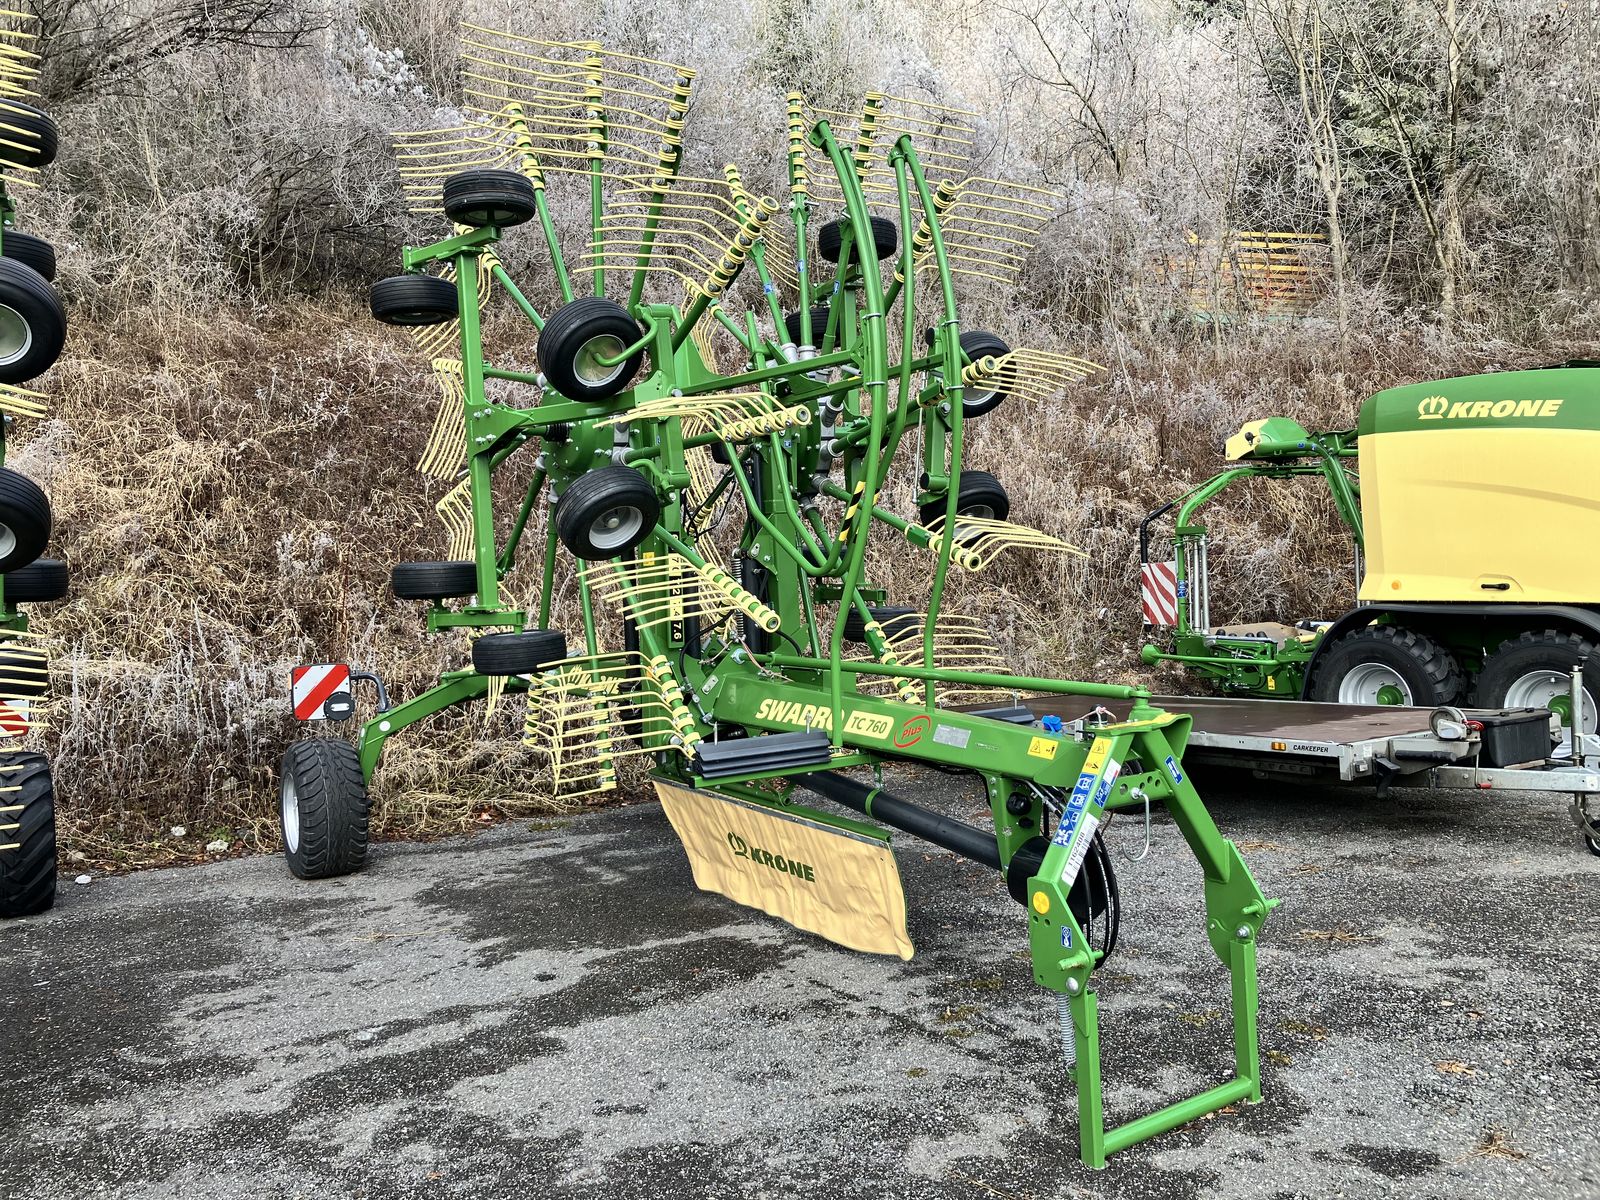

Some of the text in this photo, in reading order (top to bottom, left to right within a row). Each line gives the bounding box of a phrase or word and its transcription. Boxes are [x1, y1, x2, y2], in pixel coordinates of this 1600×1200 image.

[1447, 399, 1564, 419] KRONE
[673, 622, 682, 640] 7.6
[851, 716, 866, 730] TC
[866, 719, 888, 734] 760
[1293, 744, 1329, 753] CARKEEPER
[748, 846, 816, 883] KRONE
